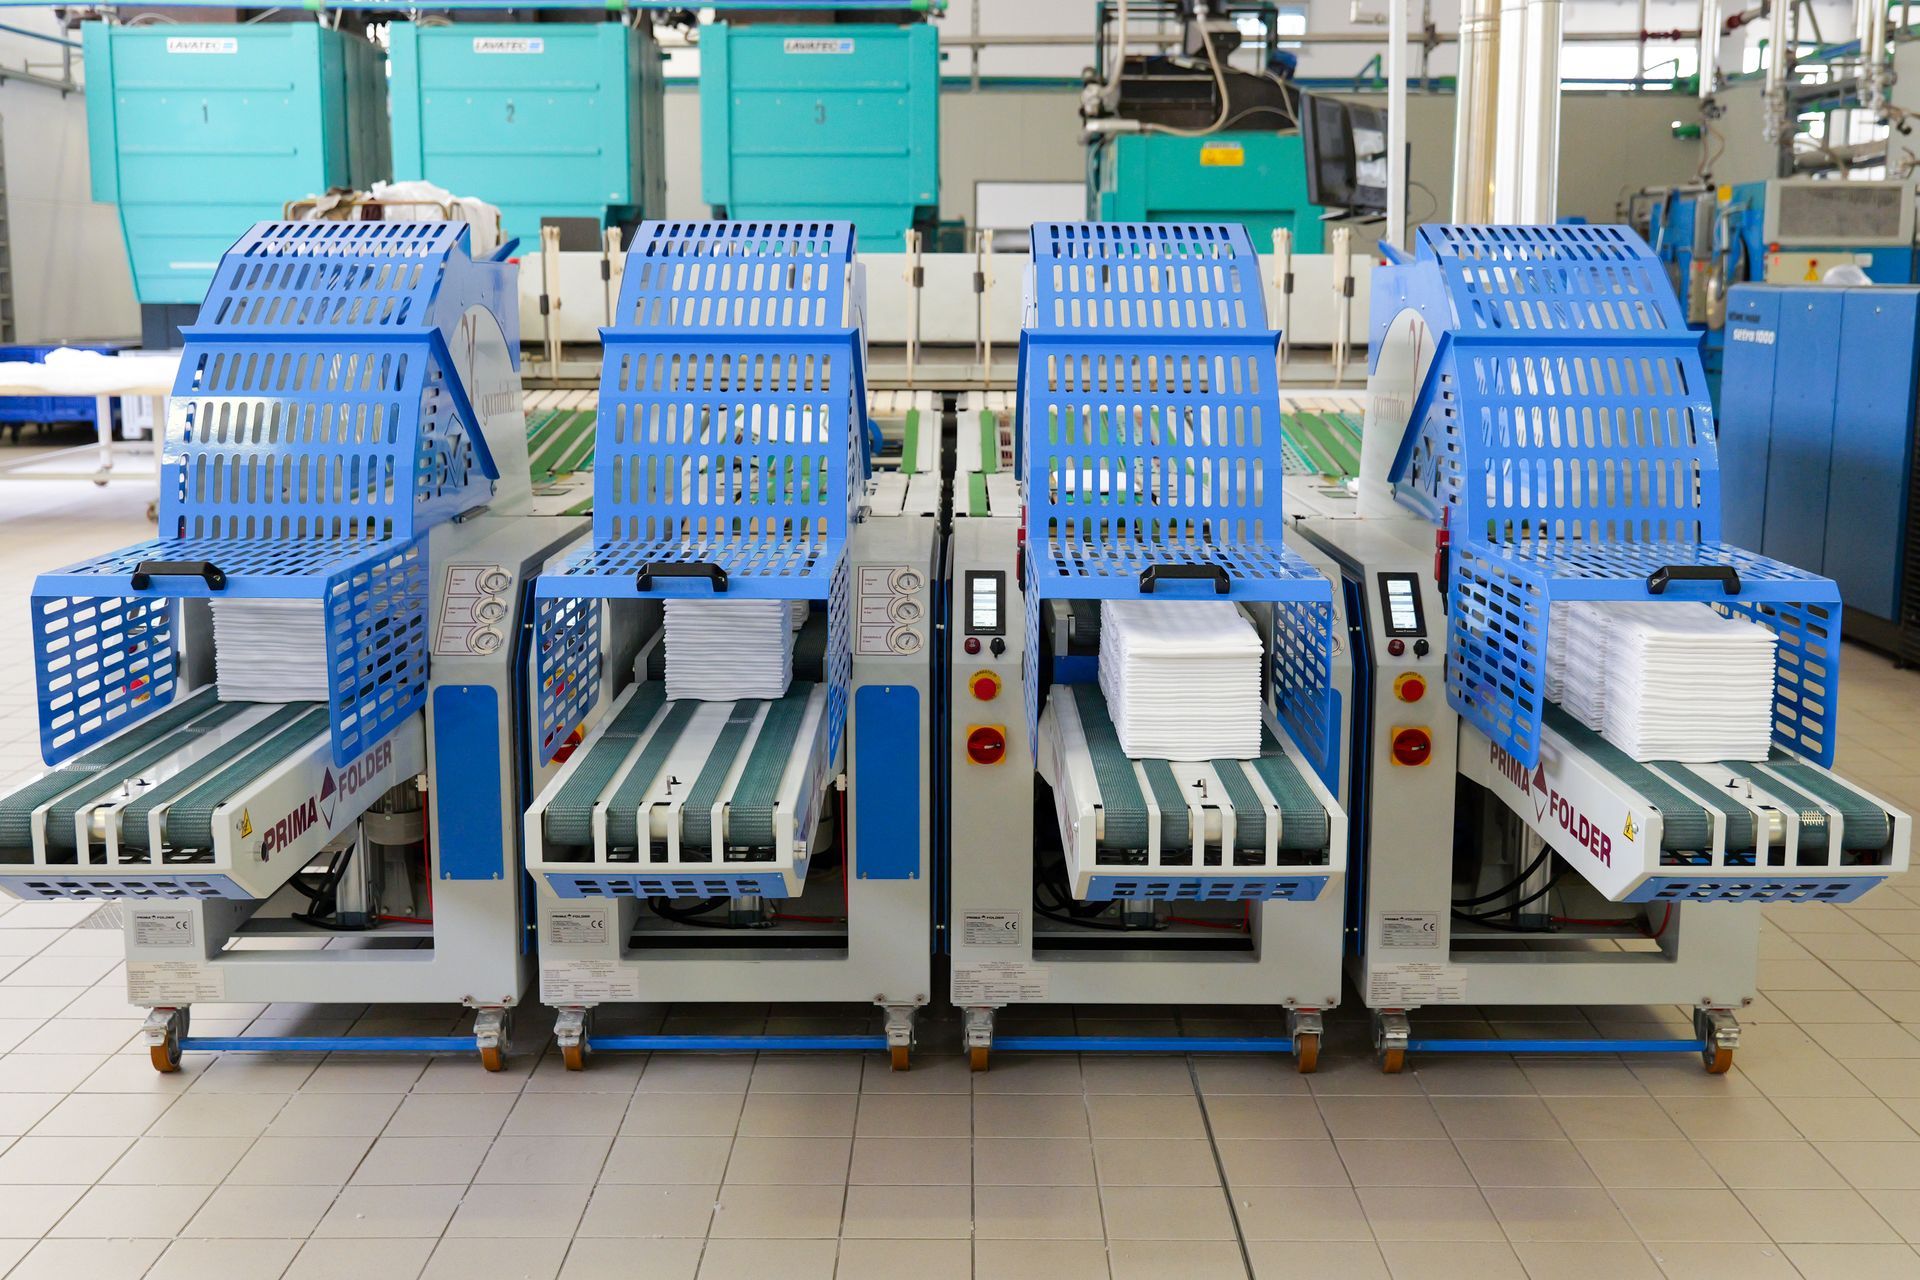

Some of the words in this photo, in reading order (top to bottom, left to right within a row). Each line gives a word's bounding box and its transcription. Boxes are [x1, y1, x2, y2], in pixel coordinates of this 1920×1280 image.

[202, 104, 209, 124] 1
[506, 104, 515, 124] 2
[814, 104, 827, 125] 3
[262, 796, 319, 862] PRIMA
[338, 739, 392, 803] FOLDER
[1490, 740, 1530, 797] PRIMA
[1549, 788, 1612, 869] FOLDER
